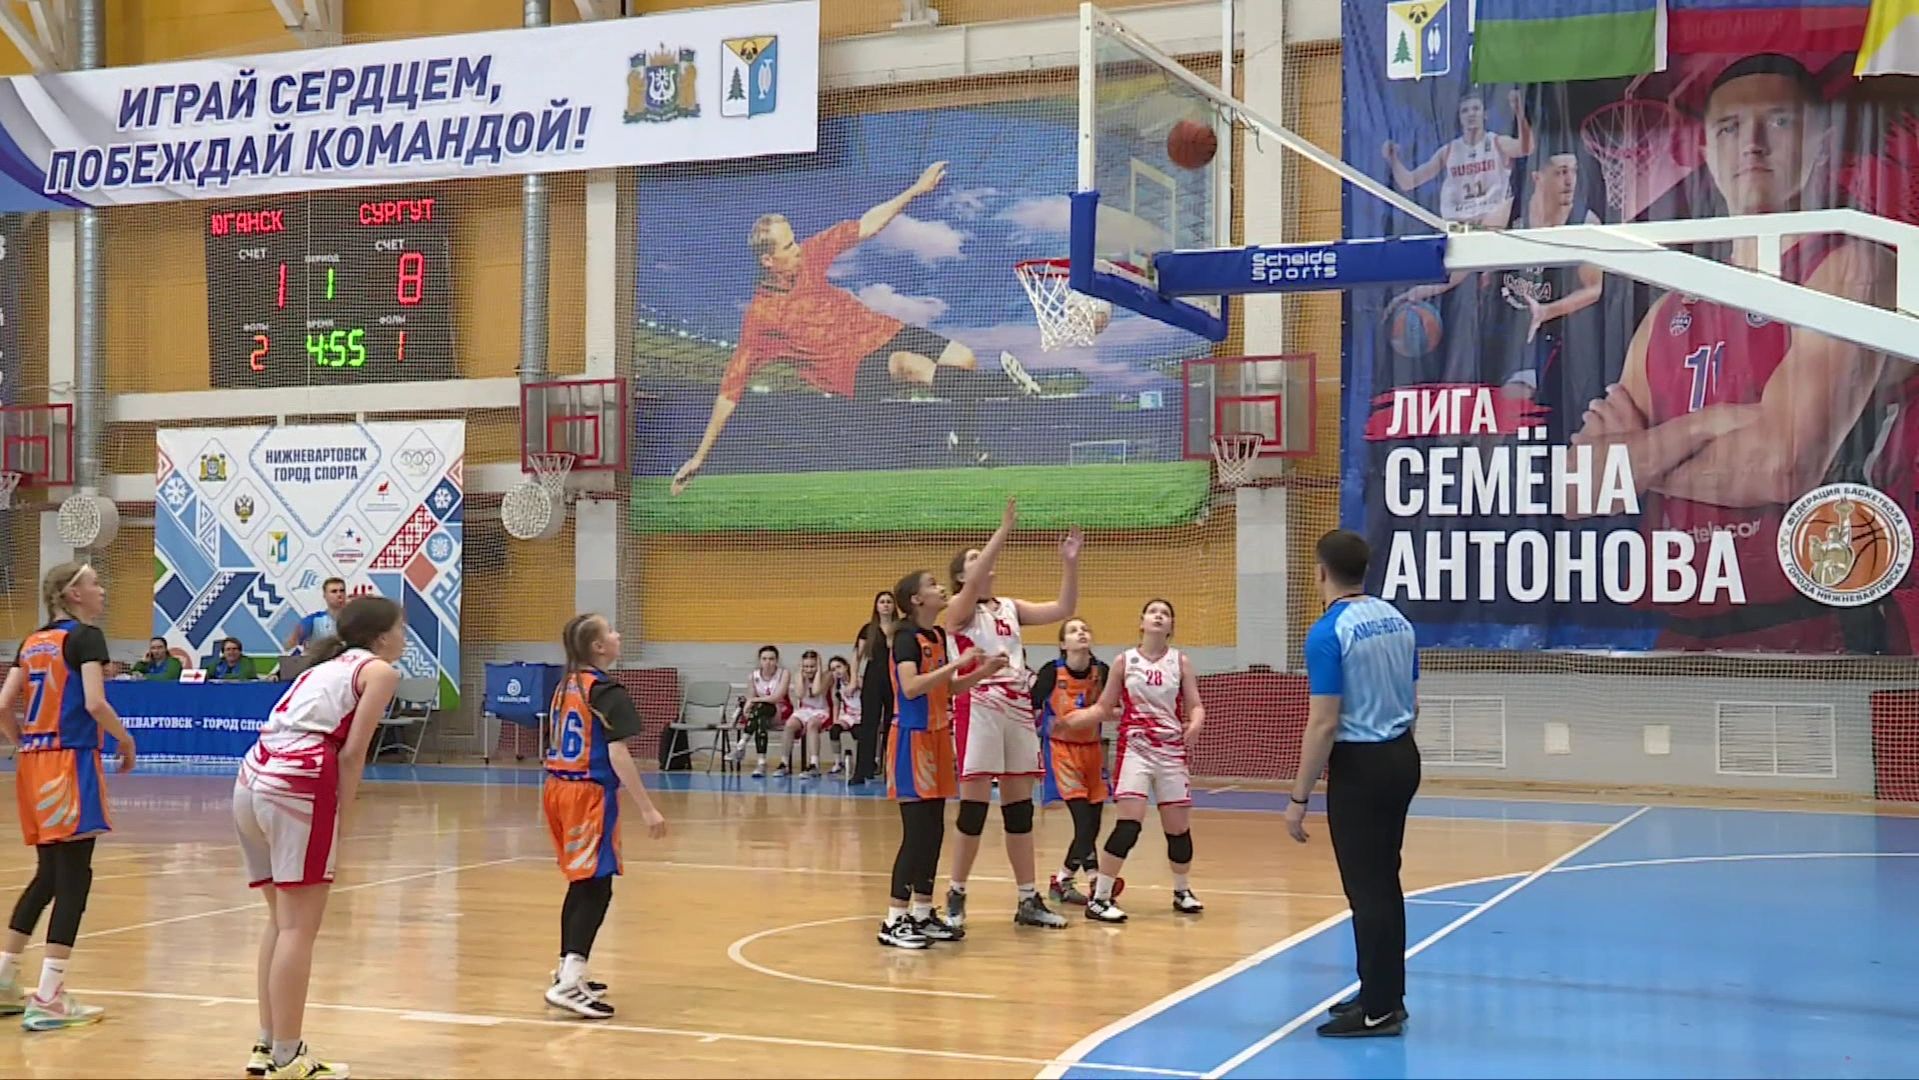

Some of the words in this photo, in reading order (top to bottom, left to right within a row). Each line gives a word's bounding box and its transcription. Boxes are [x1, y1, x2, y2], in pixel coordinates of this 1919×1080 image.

[118, 68, 258, 128] ИГРАЙ
[270, 55, 502, 116] СЕРДЦЕМ,
[47, 122, 295, 190] ПОБЕЖДАЙ
[304, 98, 592, 170] КОМАНДОЙ!
[1450, 160, 1495, 177] RUSSIA
[211, 211, 285, 236] ЮГАНСК
[359, 199, 435, 225] СУРГУТ
[239, 249, 267, 260] СЧЕТ
[375, 239, 405, 251] СЧЕТ
[278, 262, 287, 309] 1
[327, 267, 336, 300] 1
[397, 252, 424, 305] 8
[1252, 265, 1338, 284] Sports
[379, 315, 406, 326] ФОЛЫ
[250, 335, 270, 371] 2
[306, 328, 366, 367] 4:55
[397, 330, 406, 362] 1
[1386, 387, 1499, 435] ЛИГА
[266, 447, 367, 464] НИЖНЕВАРТОВСК
[1385, 426, 1640, 516] СЕМЁНА
[274, 466, 311, 484] ГОРОД
[314, 465, 358, 480] СПОРТА
[1787, 487, 1840, 526] ФЕДЕРАЦИЯ
[1844, 487, 1902, 525] БАСКЕТБОЛА
[1381, 531, 1747, 604] АНТОНОВА
[1786, 562, 1815, 595] ГОРОДА
[1817, 562, 1904, 603] НИЖНЕВАРТОВСКА
[1145, 670, 1163, 686] 28
[27, 672, 47, 723] 7
[203, 717, 239, 732] ГОРОД
